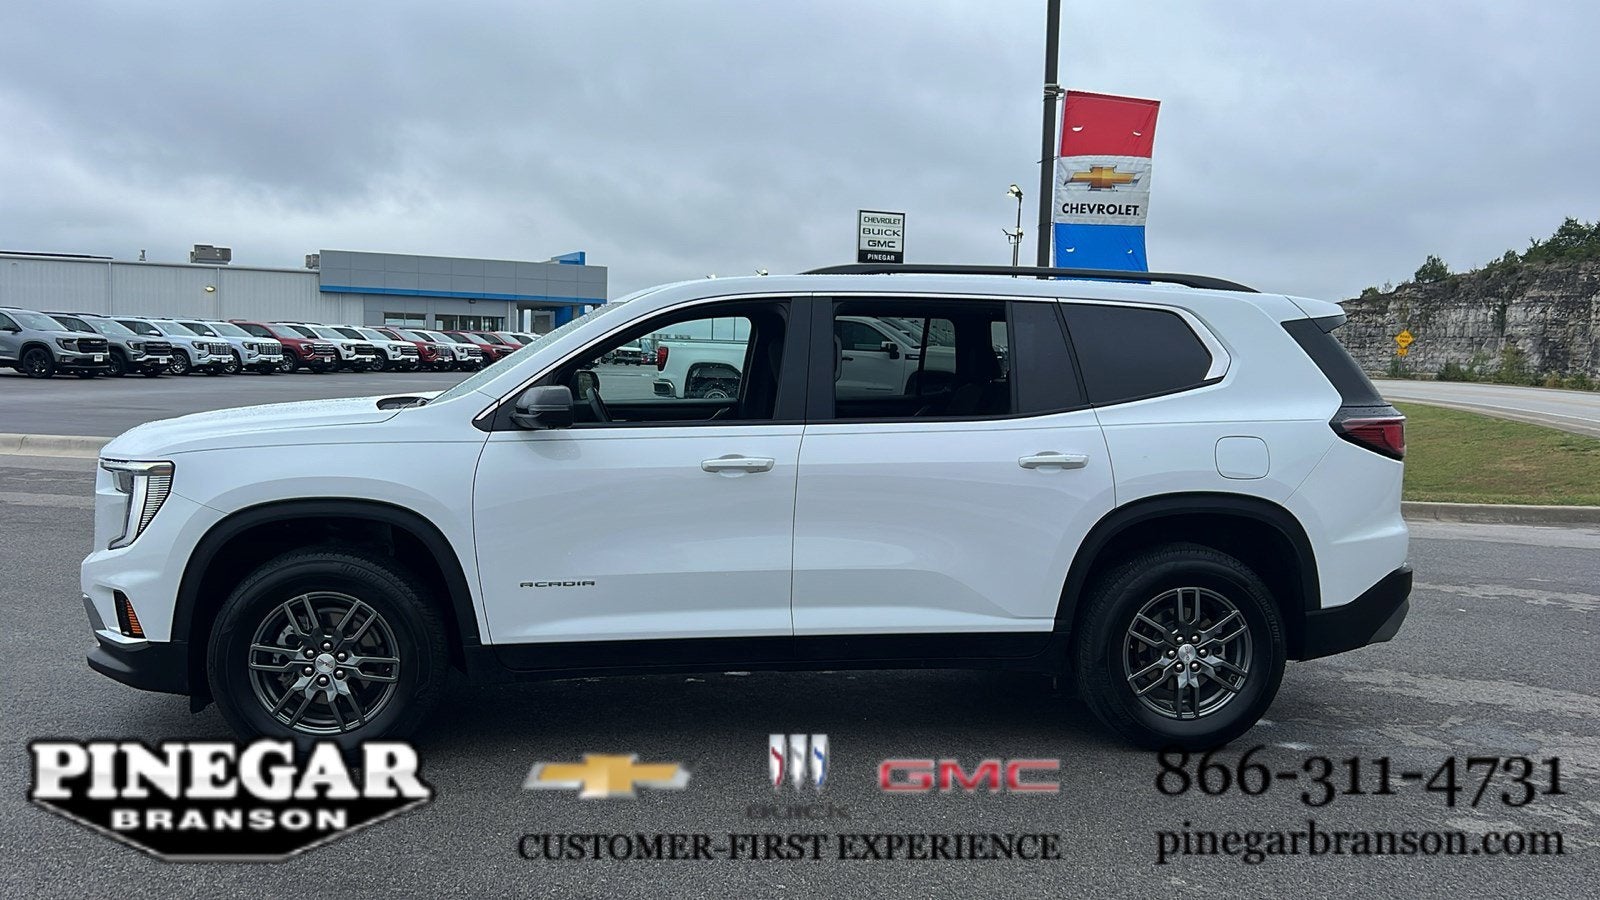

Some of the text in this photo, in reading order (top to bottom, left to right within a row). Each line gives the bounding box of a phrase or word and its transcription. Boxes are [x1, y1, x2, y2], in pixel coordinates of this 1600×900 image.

[863, 216, 901, 225] CHEVROLET
[862, 228, 901, 237] BUICK
[867, 240, 896, 248] GMC
[867, 253, 895, 261] PINEGAR
[519, 580, 596, 588] ACADIA
